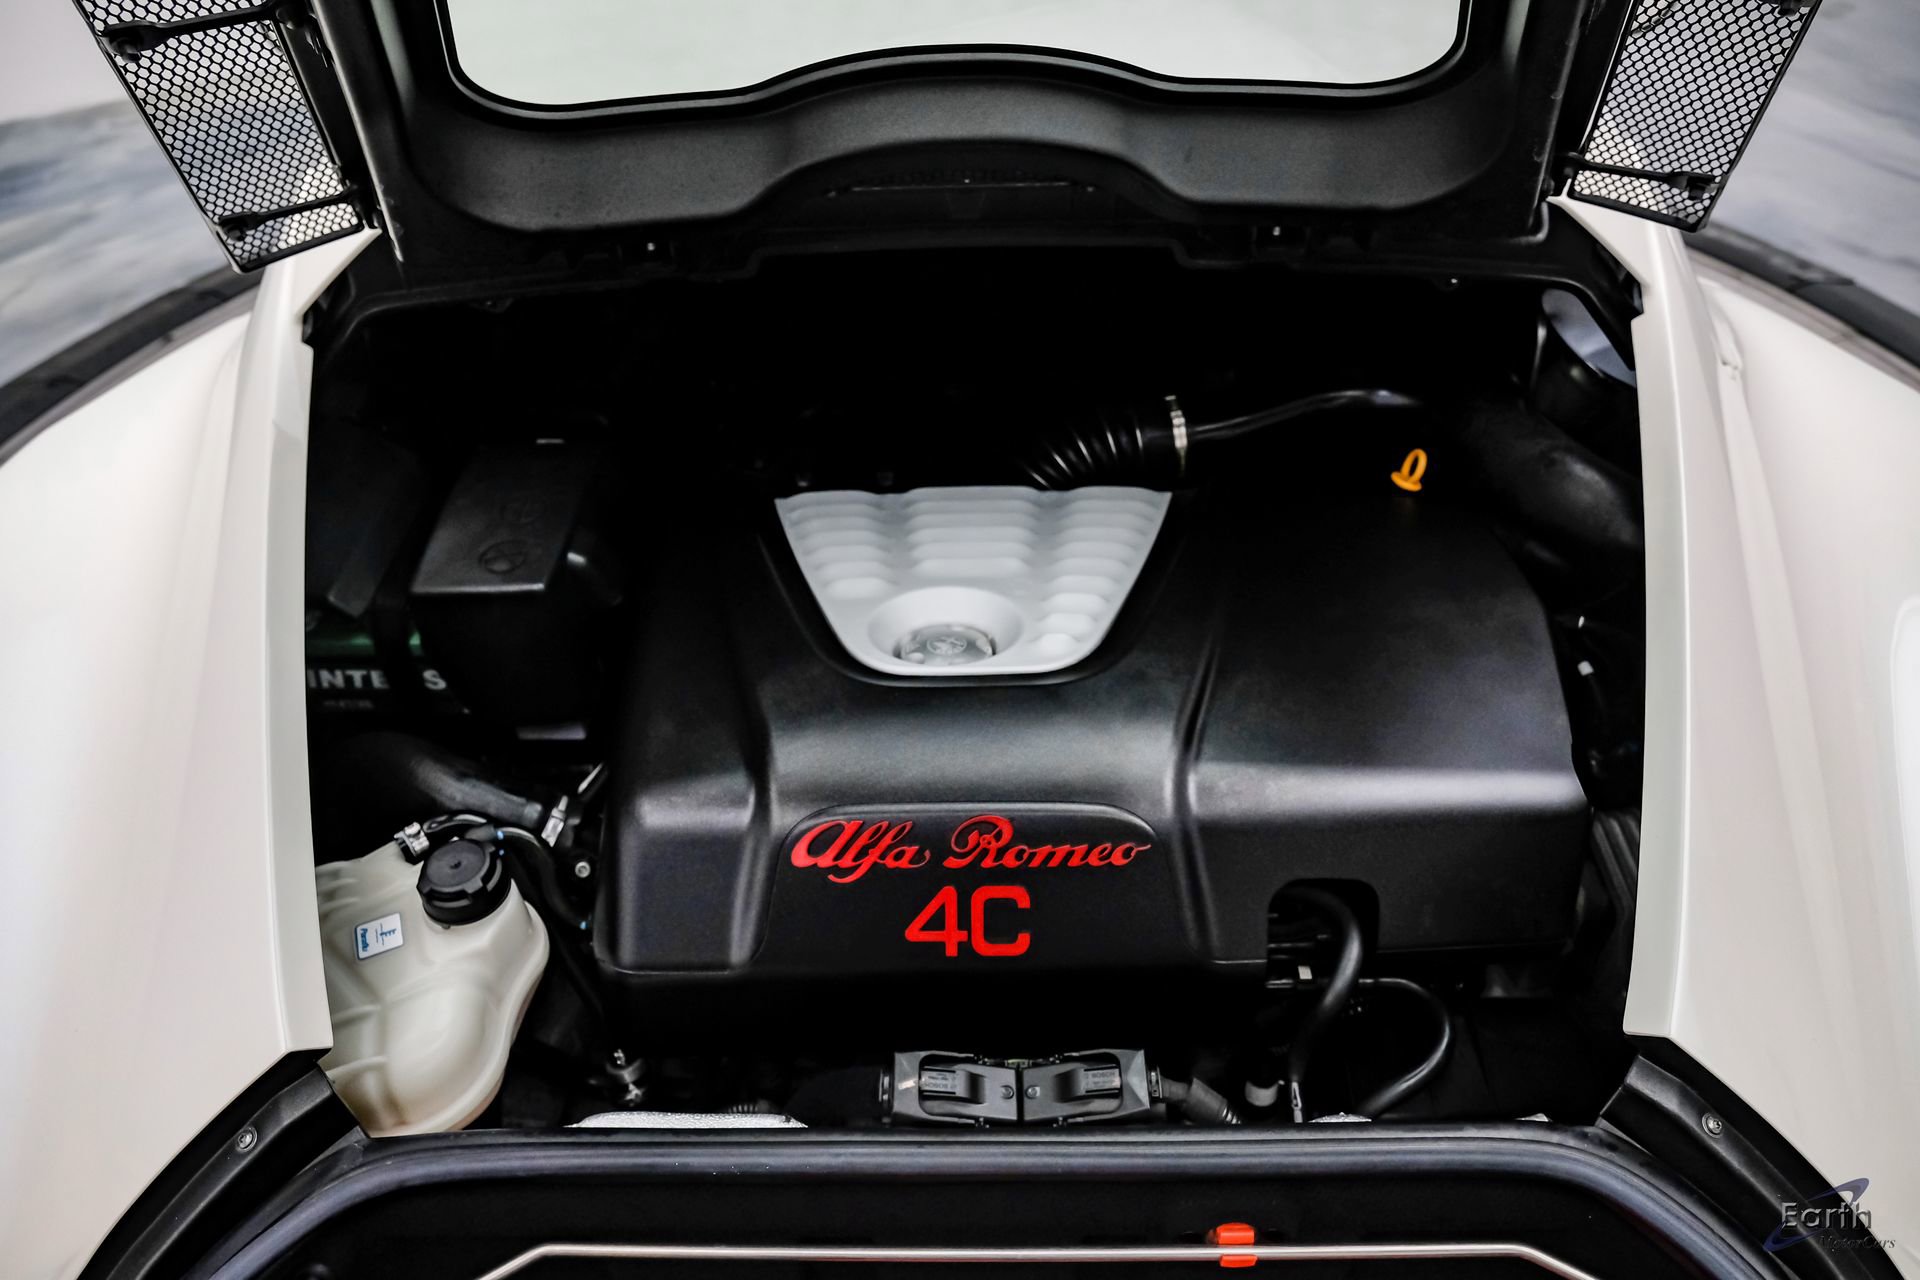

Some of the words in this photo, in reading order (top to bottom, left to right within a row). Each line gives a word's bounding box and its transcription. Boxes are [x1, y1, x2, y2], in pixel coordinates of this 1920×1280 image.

[791, 821, 930, 883] Alfa
[943, 815, 1151, 868] Romeo
[905, 886, 1030, 957] 4C
